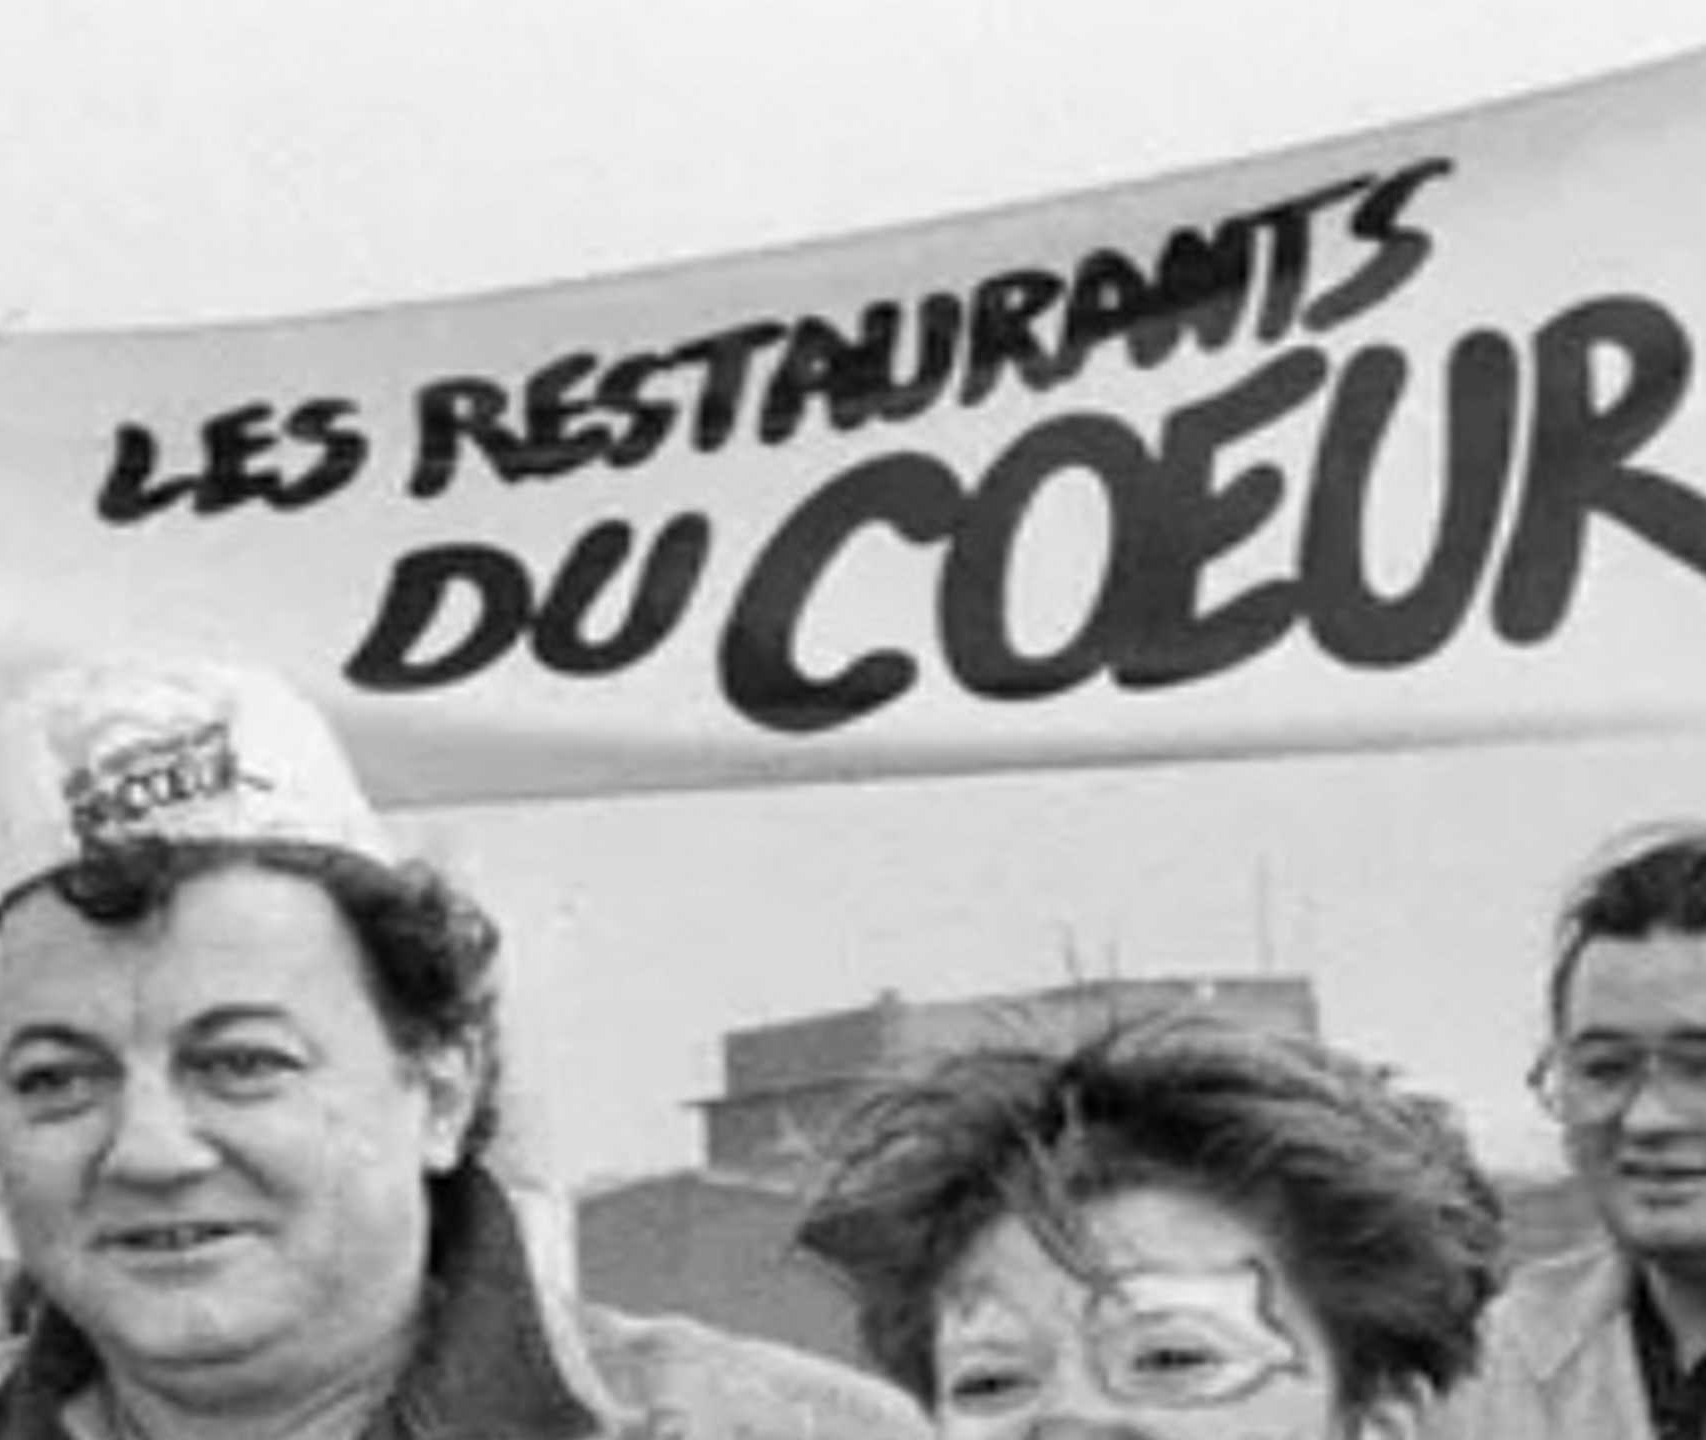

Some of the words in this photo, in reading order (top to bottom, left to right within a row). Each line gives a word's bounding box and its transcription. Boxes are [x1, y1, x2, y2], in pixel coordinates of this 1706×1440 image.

[95, 396, 370, 527] LES
[406, 156, 1455, 501] RESTAURANTS
[341, 510, 712, 694] DU
